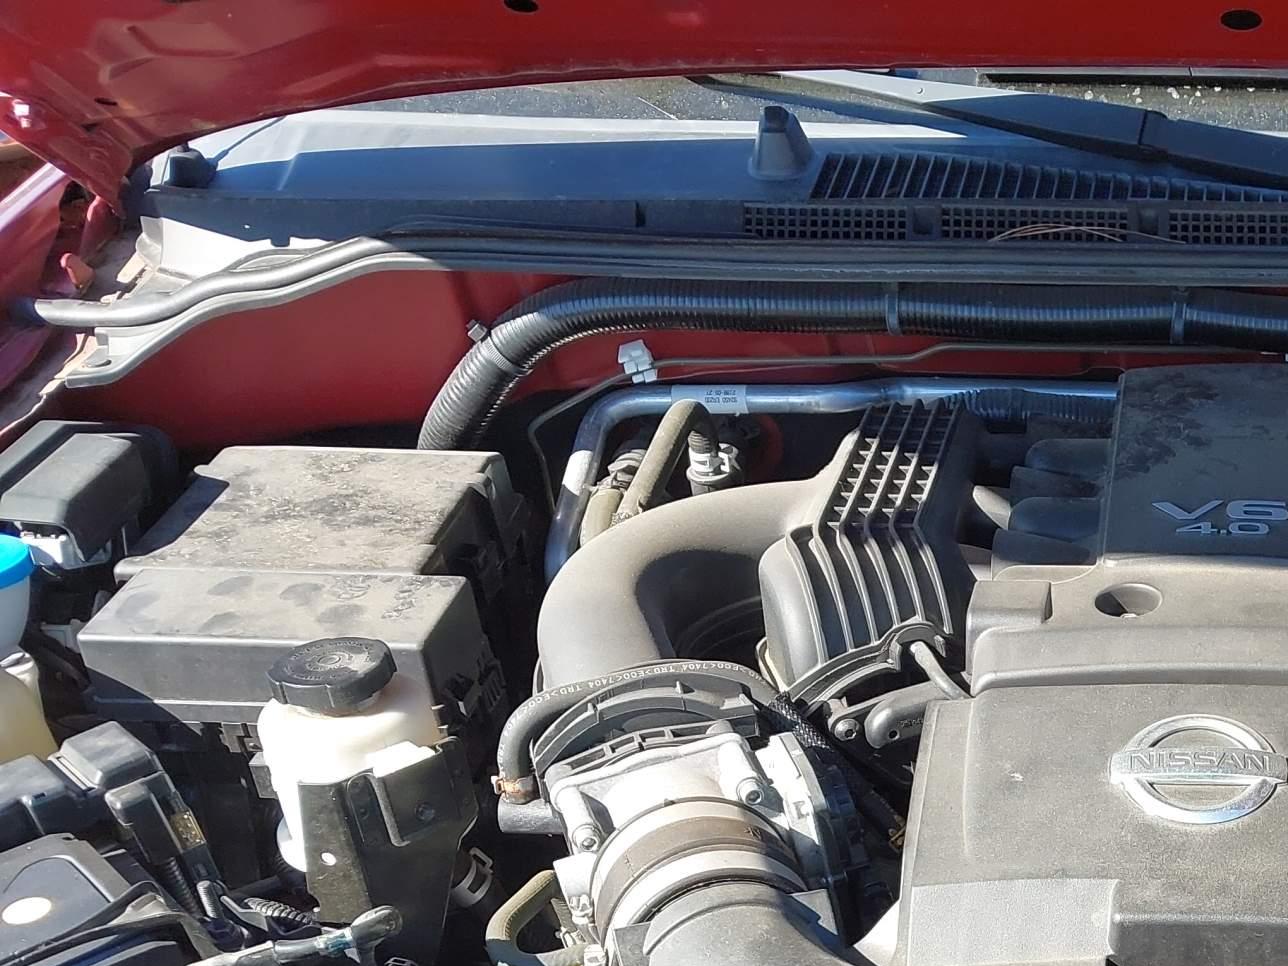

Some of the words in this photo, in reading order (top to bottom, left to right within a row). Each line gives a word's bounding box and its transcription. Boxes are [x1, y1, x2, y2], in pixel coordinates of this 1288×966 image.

[1152, 500, 1288, 520] V6
[1176, 521, 1270, 536] 4.0
[1129, 752, 1271, 771] NISSAN
